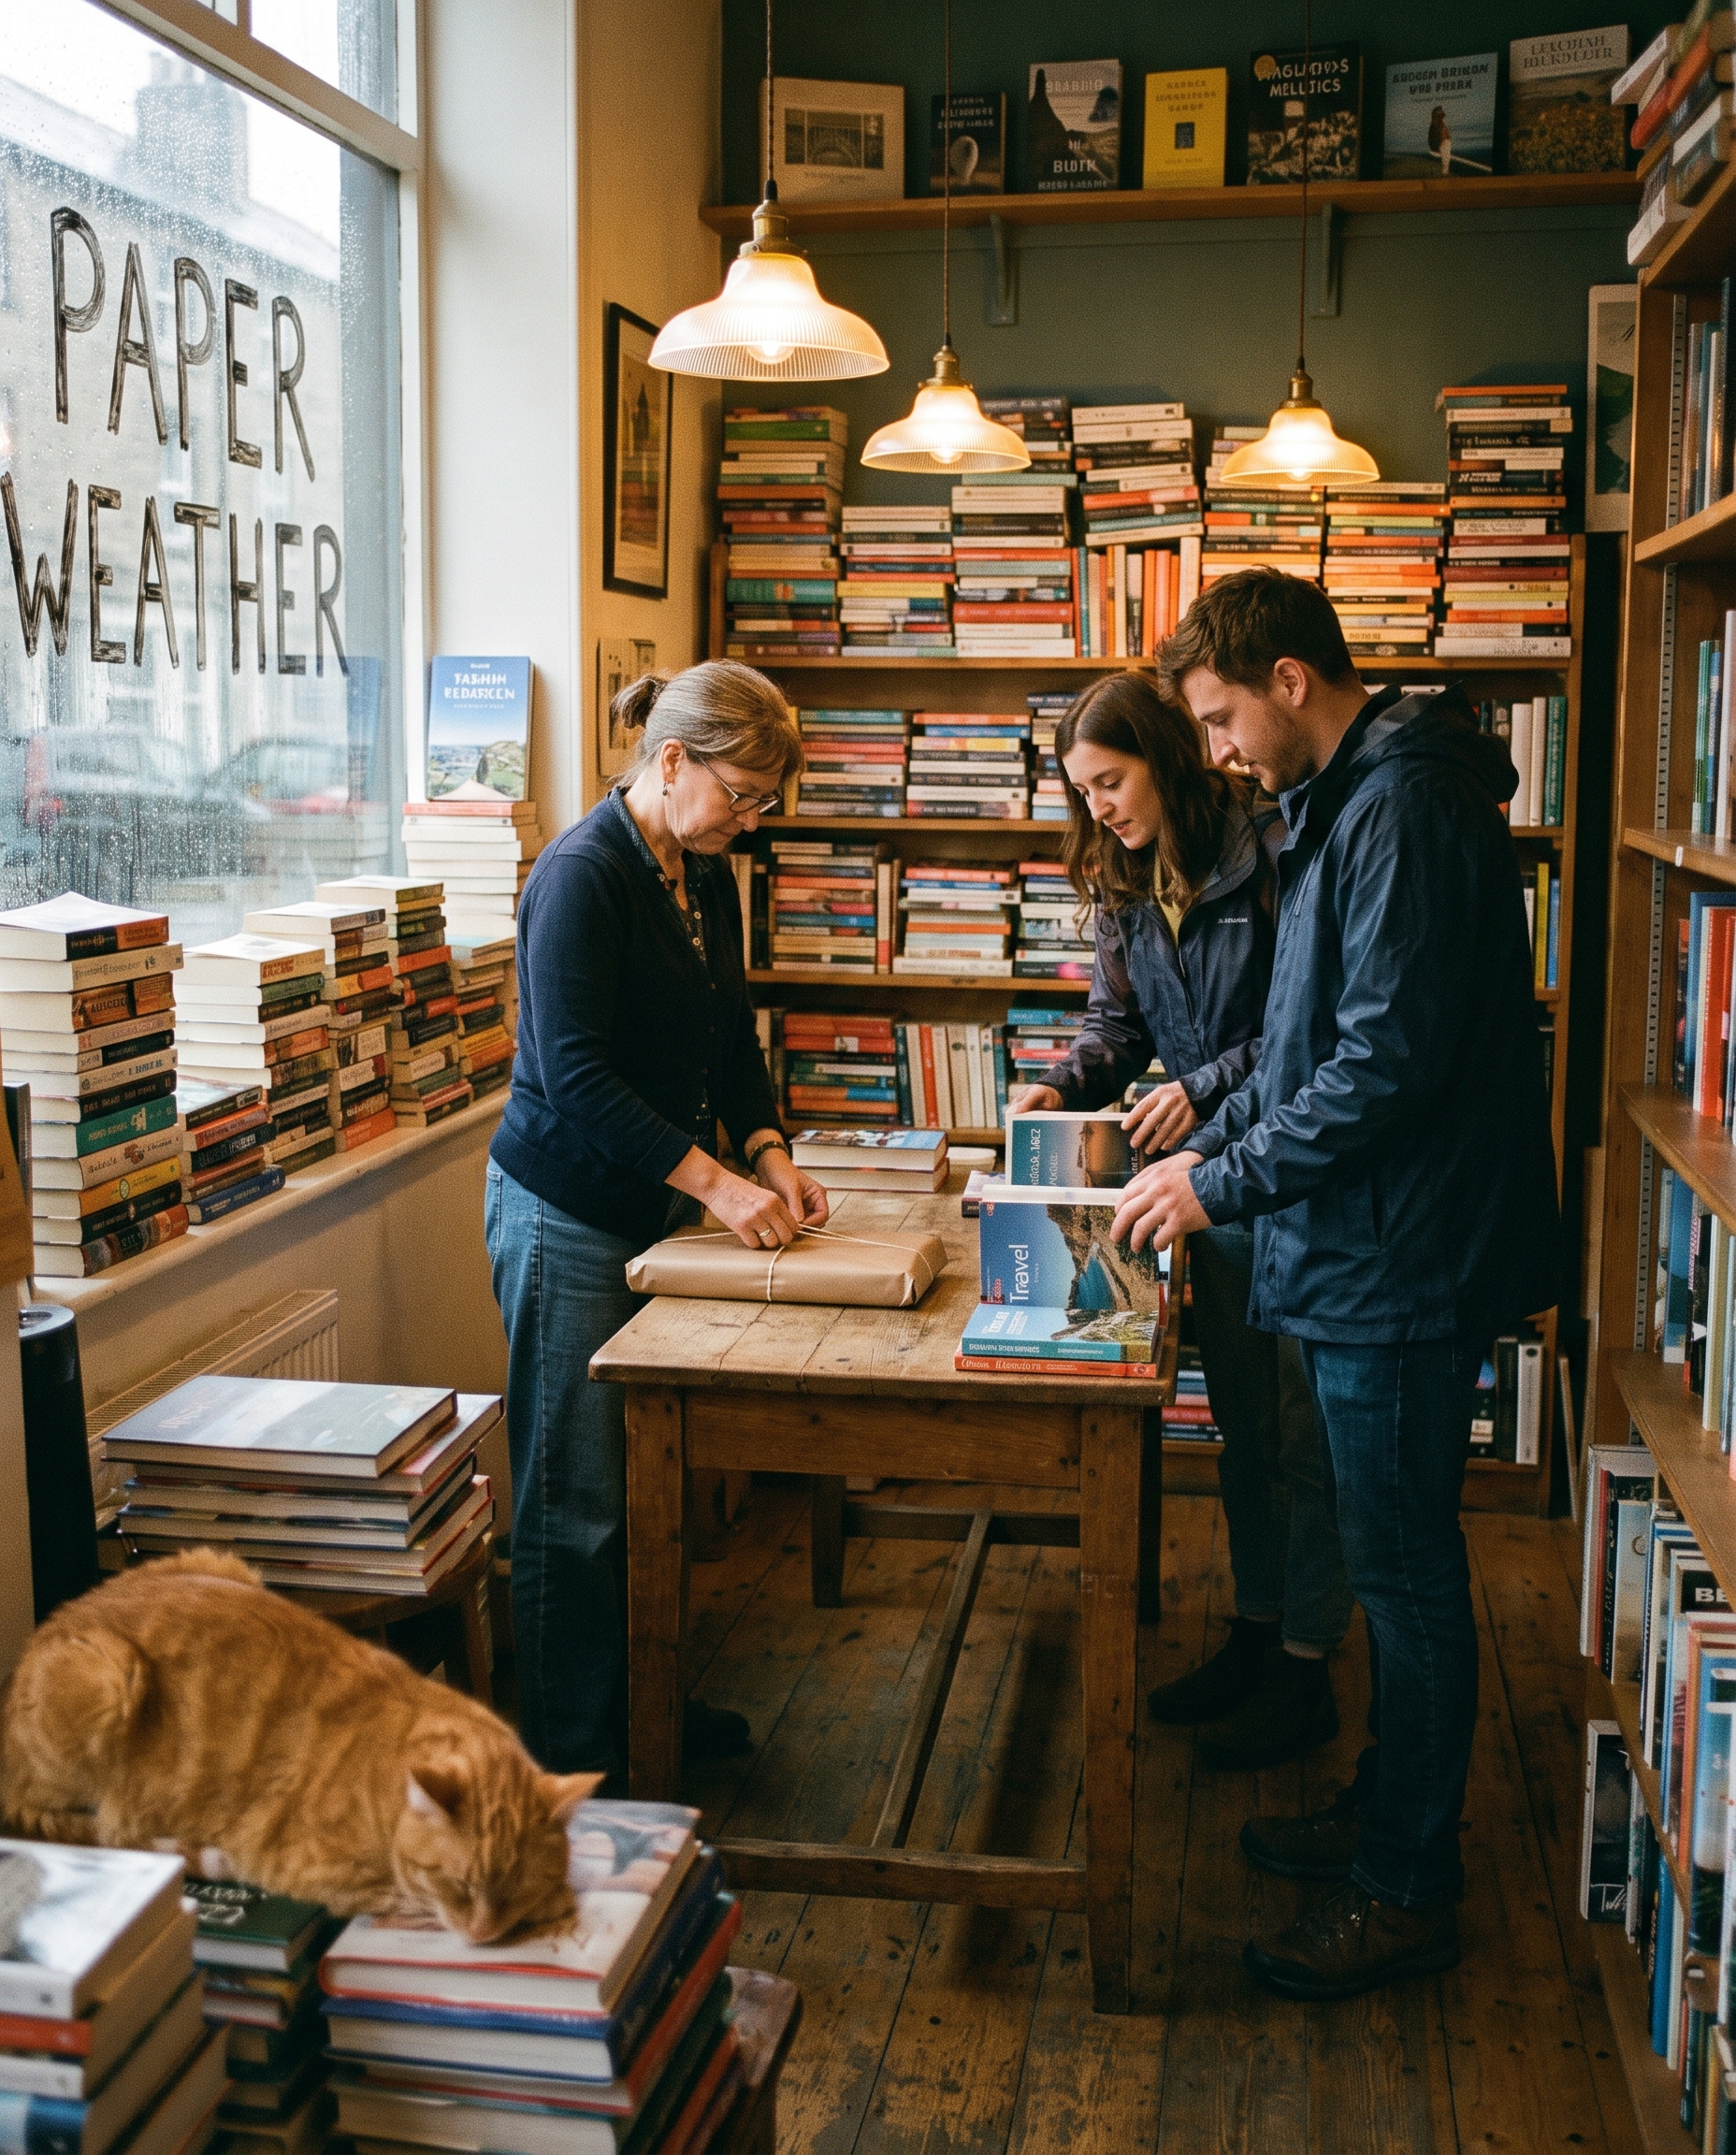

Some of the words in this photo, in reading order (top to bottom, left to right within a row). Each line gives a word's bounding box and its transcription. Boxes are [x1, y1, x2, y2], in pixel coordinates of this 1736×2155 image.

[51, 206, 315, 483] PAPER
[1, 470, 349, 677] WEATHER
[1008, 1244, 1030, 1303] Travel
